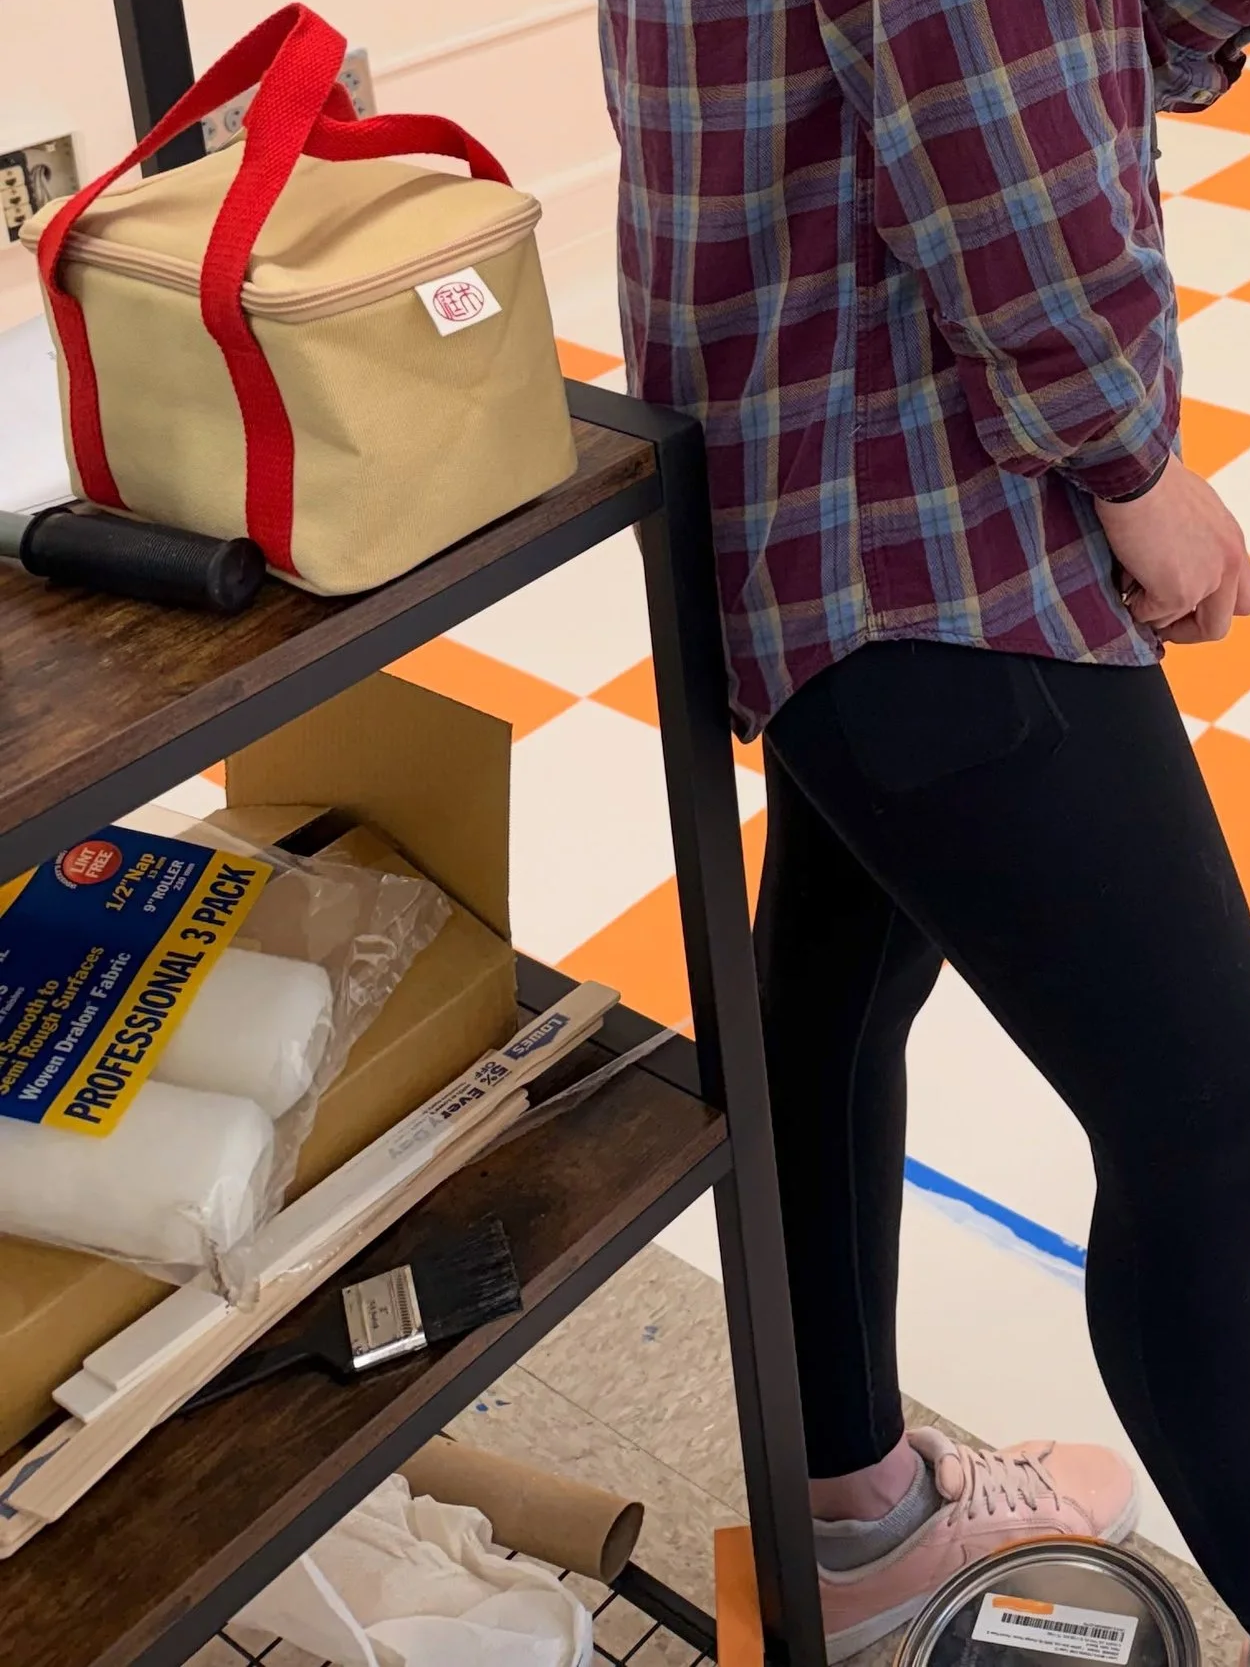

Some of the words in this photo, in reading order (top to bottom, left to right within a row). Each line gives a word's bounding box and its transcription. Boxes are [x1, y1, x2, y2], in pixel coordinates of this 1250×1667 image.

[70, 847, 97, 874] LINT
[85, 849, 115, 879] FREE
[128, 853, 157, 883] Nap
[152, 859, 186, 901] ROLLER
[192, 863, 257, 926] PACK
[180, 927, 217, 945] 3
[1, 998, 48, 1054] Smooth
[37, 979, 60, 1000] to
[18, 1012, 63, 1059] Rough
[52, 946, 105, 1010] Surfaces
[18, 1055, 66, 1101] Woven
[90, 951, 132, 999] Fabric
[63, 950, 206, 1124] PROFESSIONAL
[479, 1064, 509, 1086] 5%
